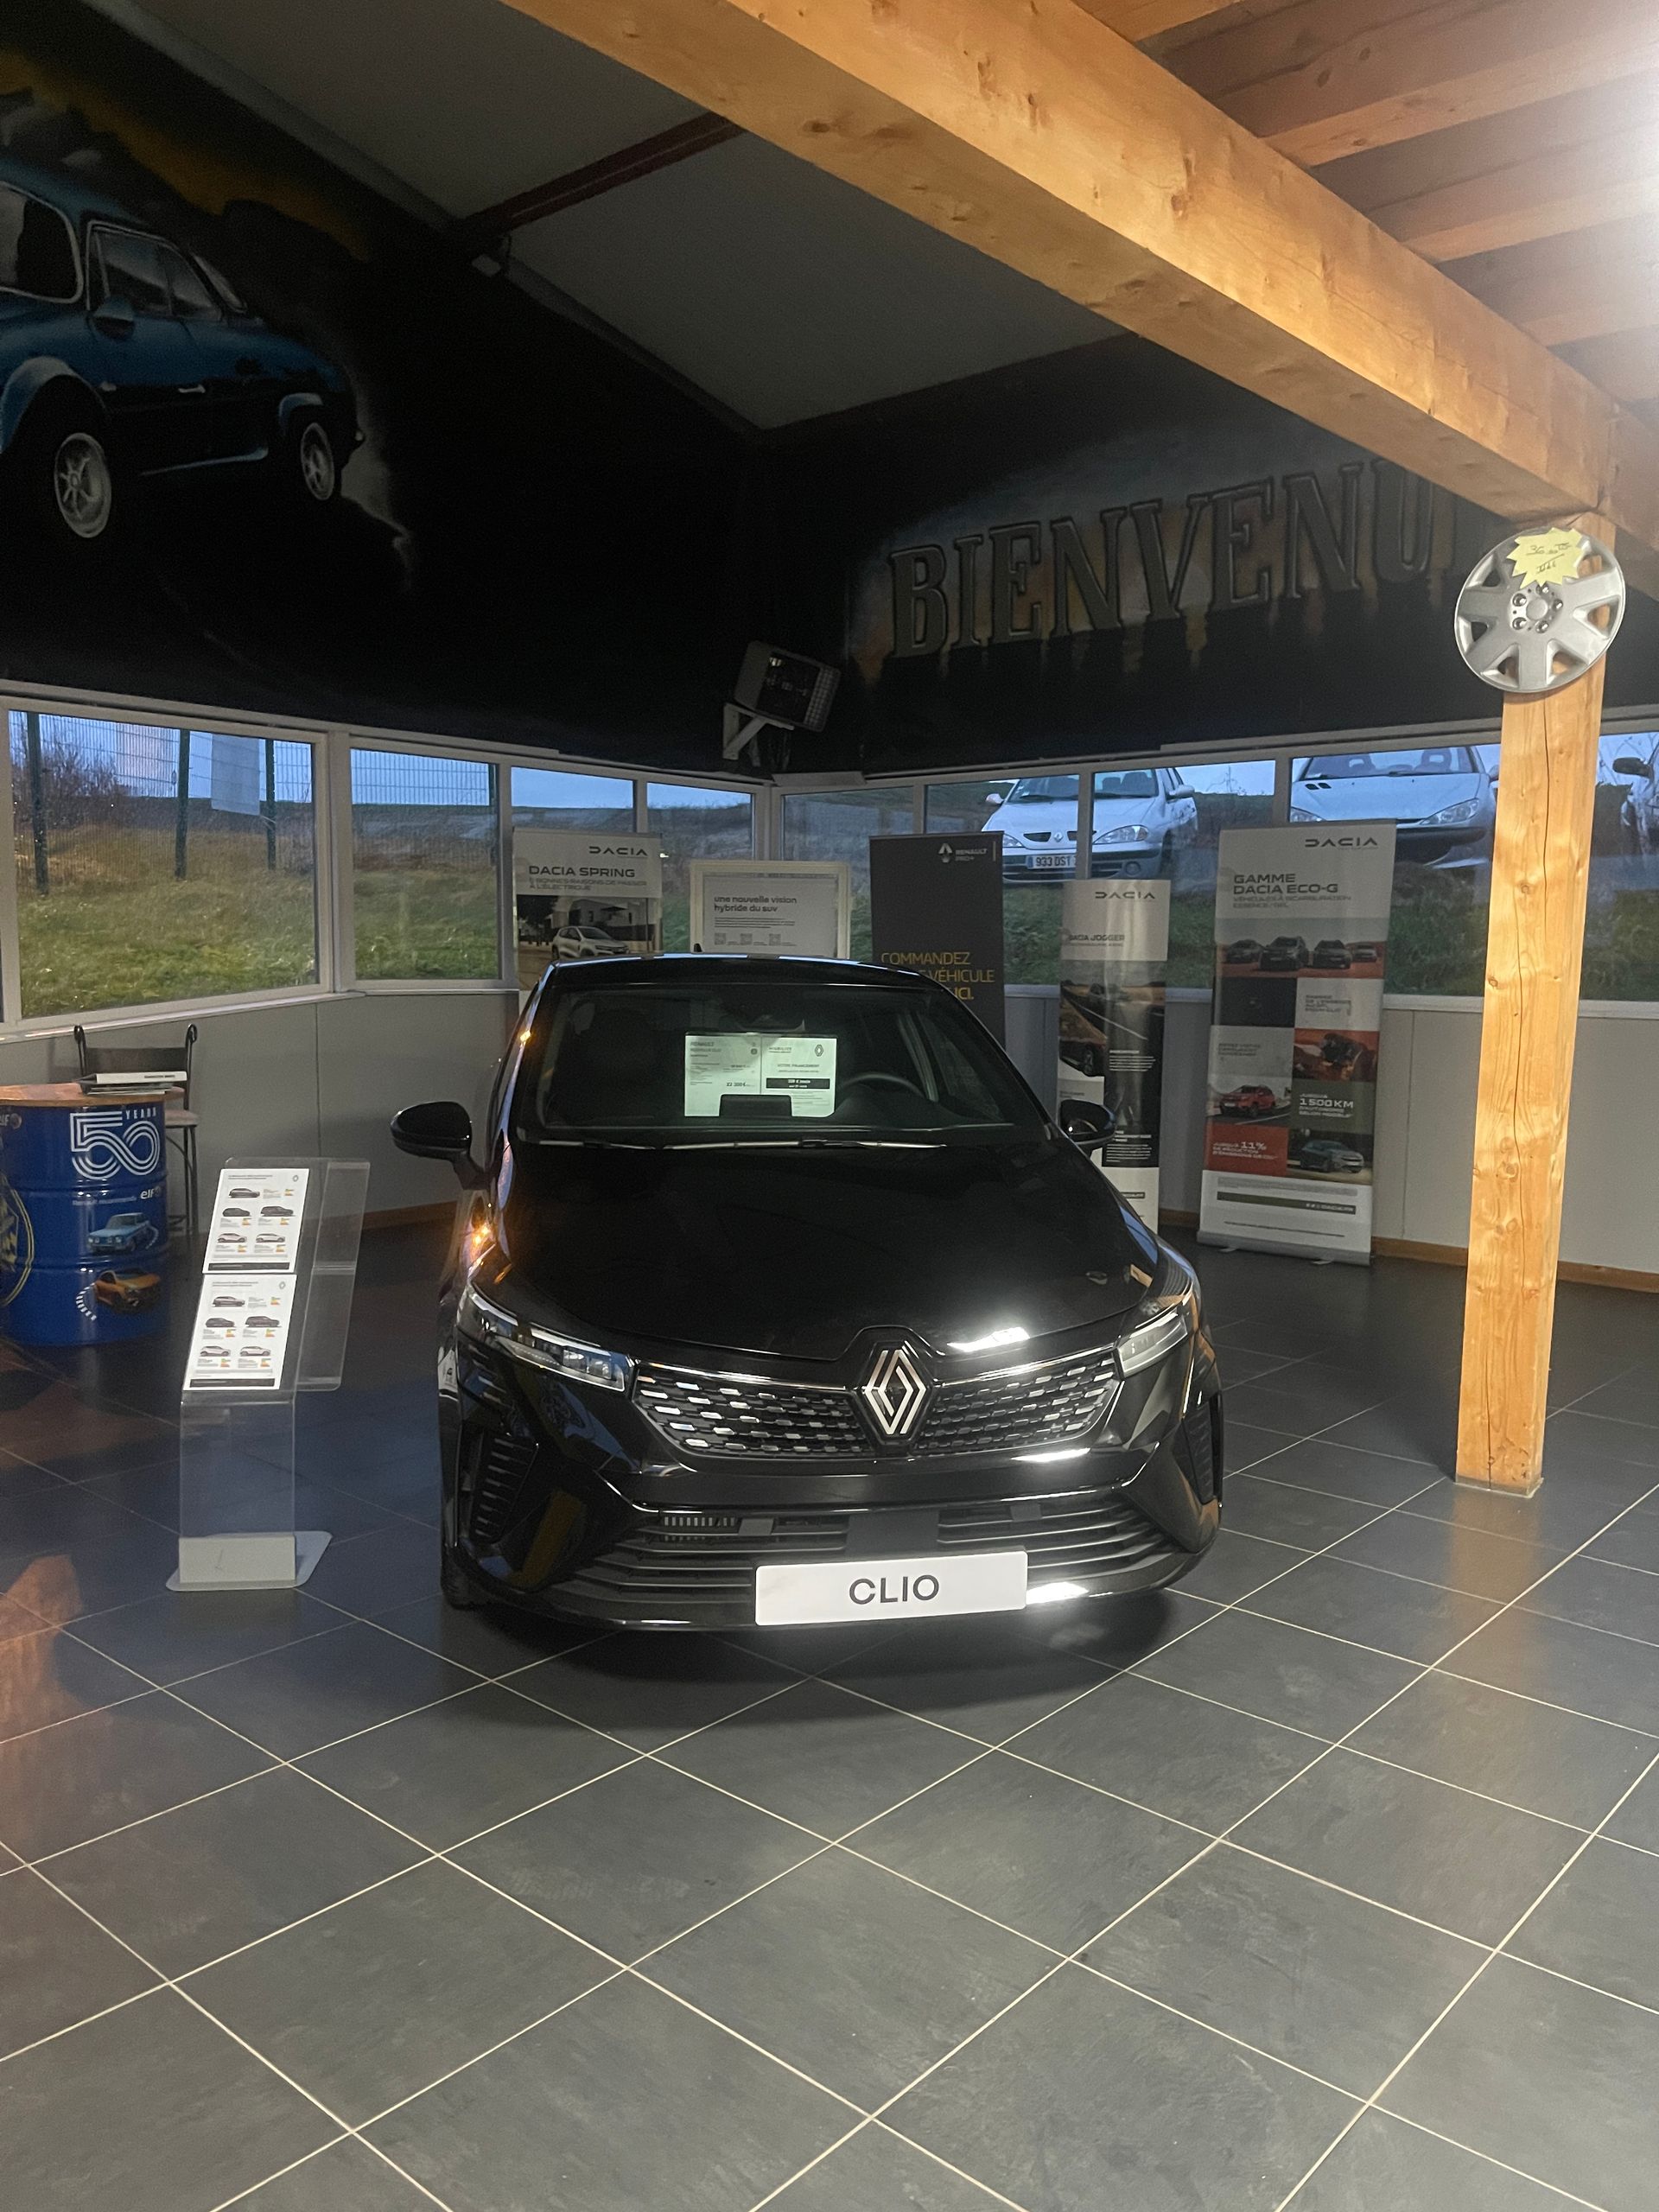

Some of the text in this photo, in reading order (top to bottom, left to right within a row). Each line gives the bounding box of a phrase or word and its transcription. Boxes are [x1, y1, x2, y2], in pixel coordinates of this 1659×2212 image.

[1305, 837, 1378, 848] DACIA
[588, 846, 648, 856] DACIA
[1036, 856, 1053, 867] 933
[529, 866, 636, 878] DACIA SPRING
[1234, 874, 1296, 884] GAMME
[1233, 883, 1338, 895] DACIA ECO-G
[771, 895, 798, 904] vision
[1095, 891, 1155, 899] DACIA
[714, 904, 747, 913] hybride
[881, 951, 971, 965] COMMANDEZ
[929, 966, 995, 982] VÉHICULE
[125, 1107, 157, 1120] YEARS
[70, 1111, 161, 1180] 50
[1241, 1141, 1268, 1151] 11%
[140, 1188, 156, 1199] elf
[849, 1574, 939, 1605] CLIO
